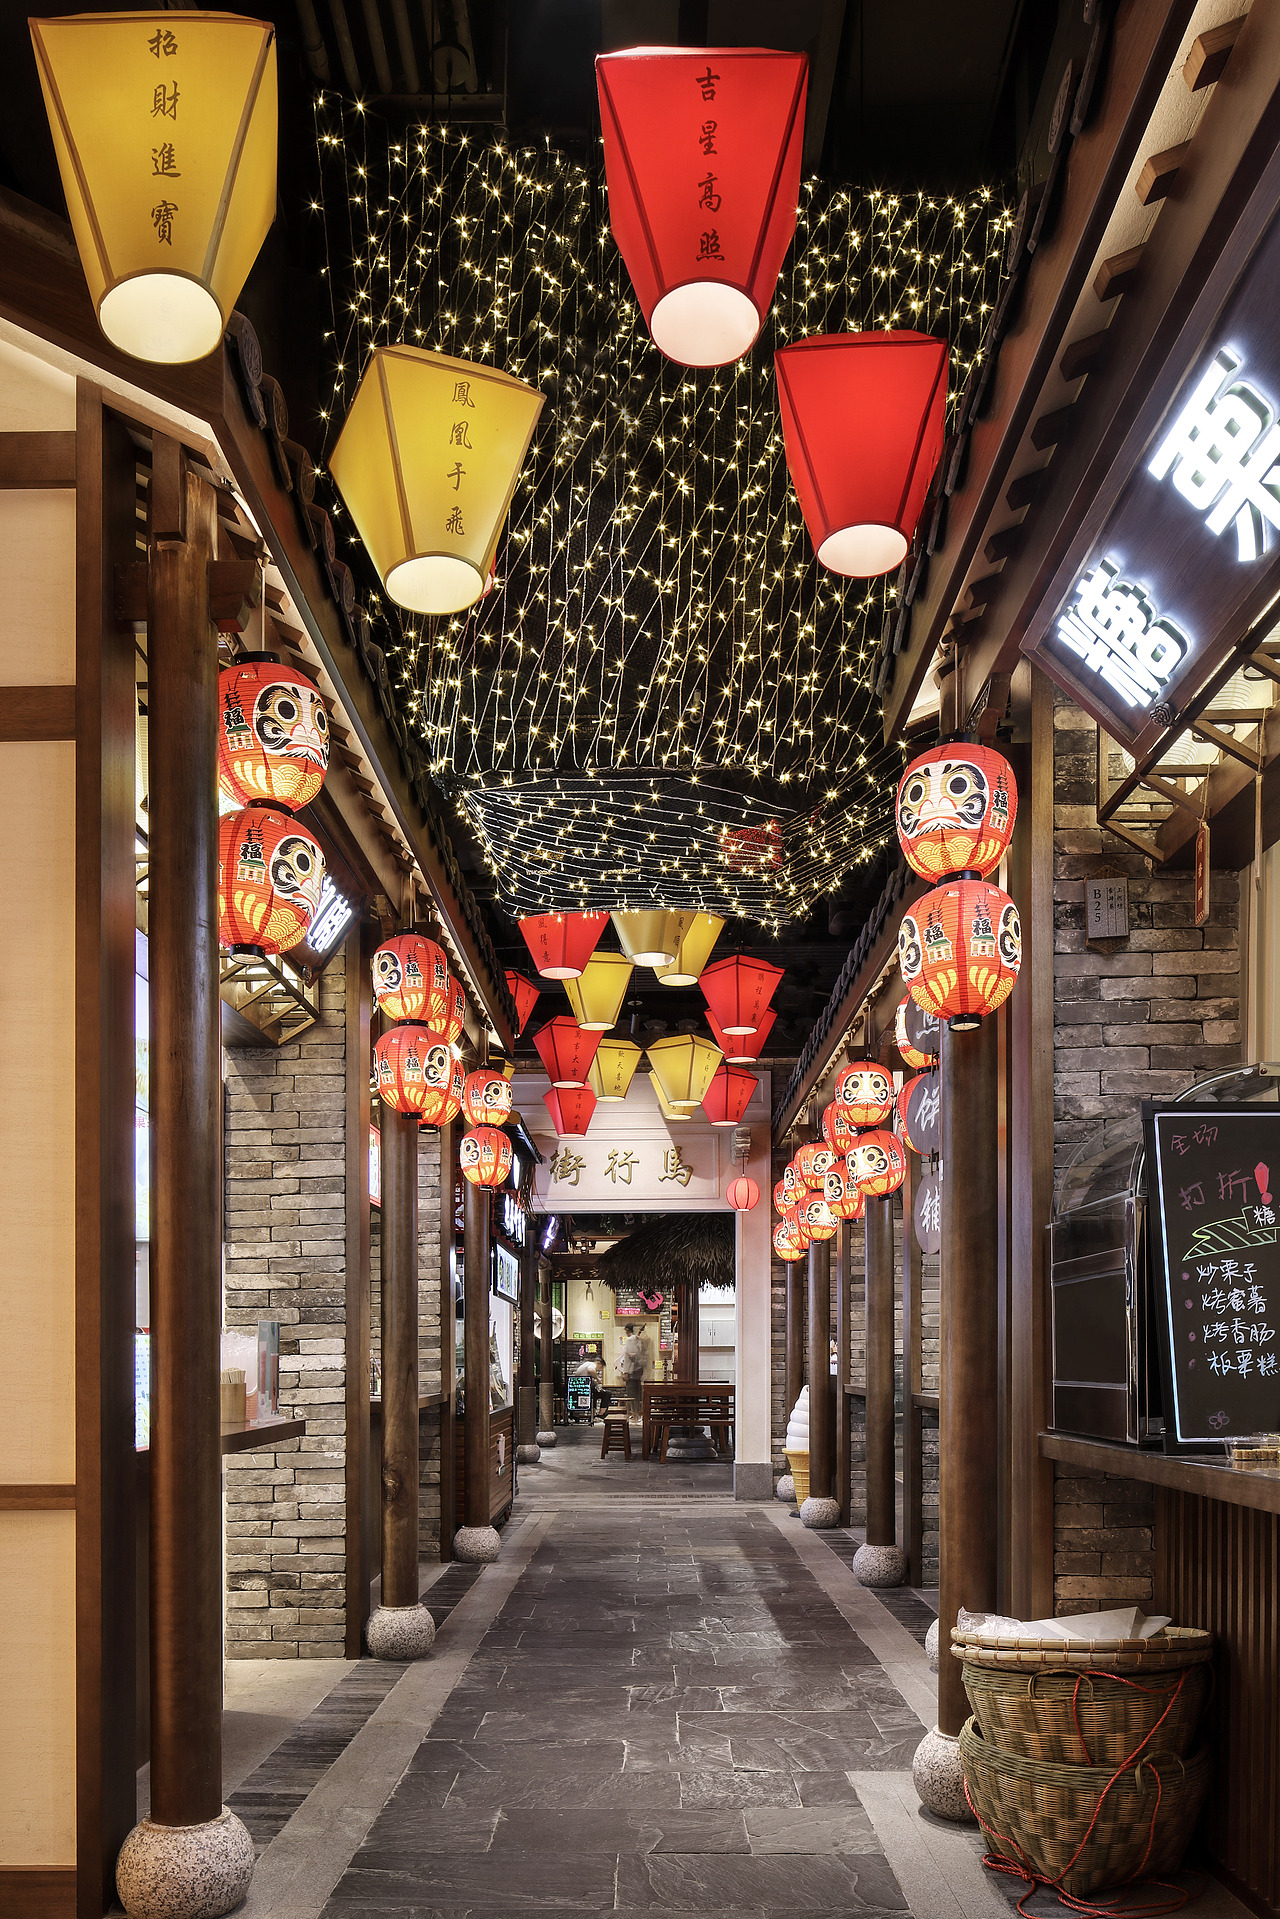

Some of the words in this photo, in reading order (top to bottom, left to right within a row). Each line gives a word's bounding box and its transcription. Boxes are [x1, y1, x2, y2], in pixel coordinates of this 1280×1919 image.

[148, 28, 182, 247] 招財進寶
[694, 67, 725, 263] 吉星高照
[445, 381, 476, 537] 鳳凰于飛
[223, 707, 245, 728] 福
[992, 790, 1008, 809] 福
[239, 842, 263, 860] 福
[1093, 888, 1102, 923] B25
[924, 923, 944, 944] 福
[971, 918, 993, 936] 福
[404, 962, 420, 975] 福
[404, 1056, 419, 1069] 福
[570, 1030, 582, 1077] 萬事大吉
[1170, 1123, 1219, 1156] 全场
[1195, 1259, 1258, 1285] 炒栗子
[1202, 1317, 1276, 1347] 烤香肠
